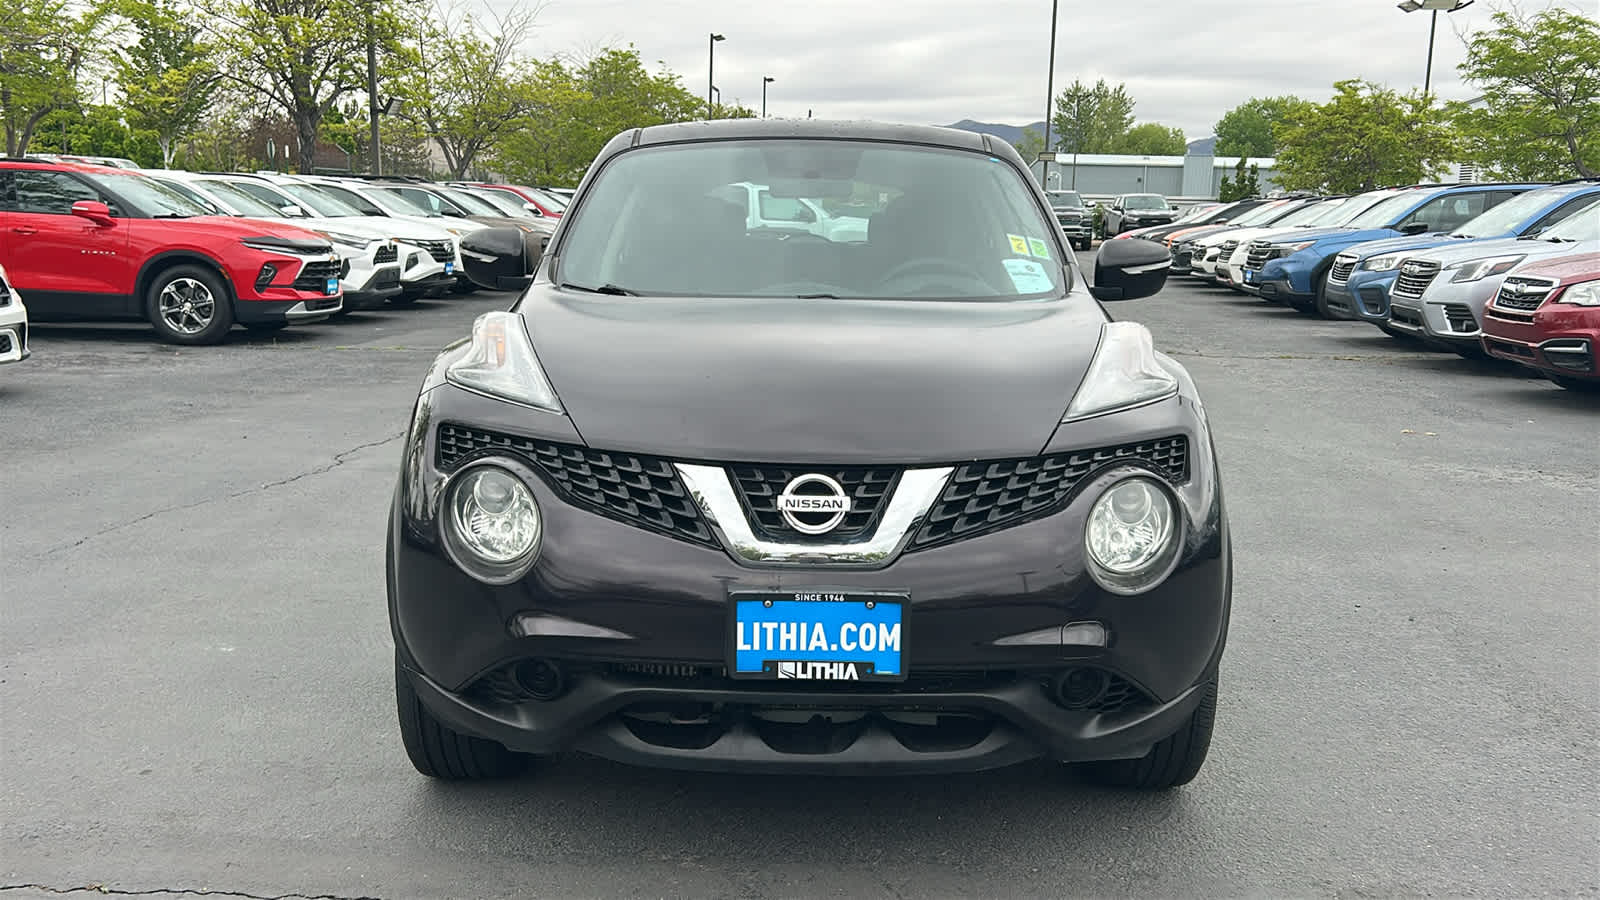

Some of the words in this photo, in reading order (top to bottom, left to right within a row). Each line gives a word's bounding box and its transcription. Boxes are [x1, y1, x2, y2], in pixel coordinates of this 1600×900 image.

[785, 499, 843, 509] NISSAN
[794, 593, 822, 602] SINCE
[824, 593, 845, 602] 1946
[736, 621, 902, 652] LITHIA.COM
[796, 661, 859, 681] LITHIA
